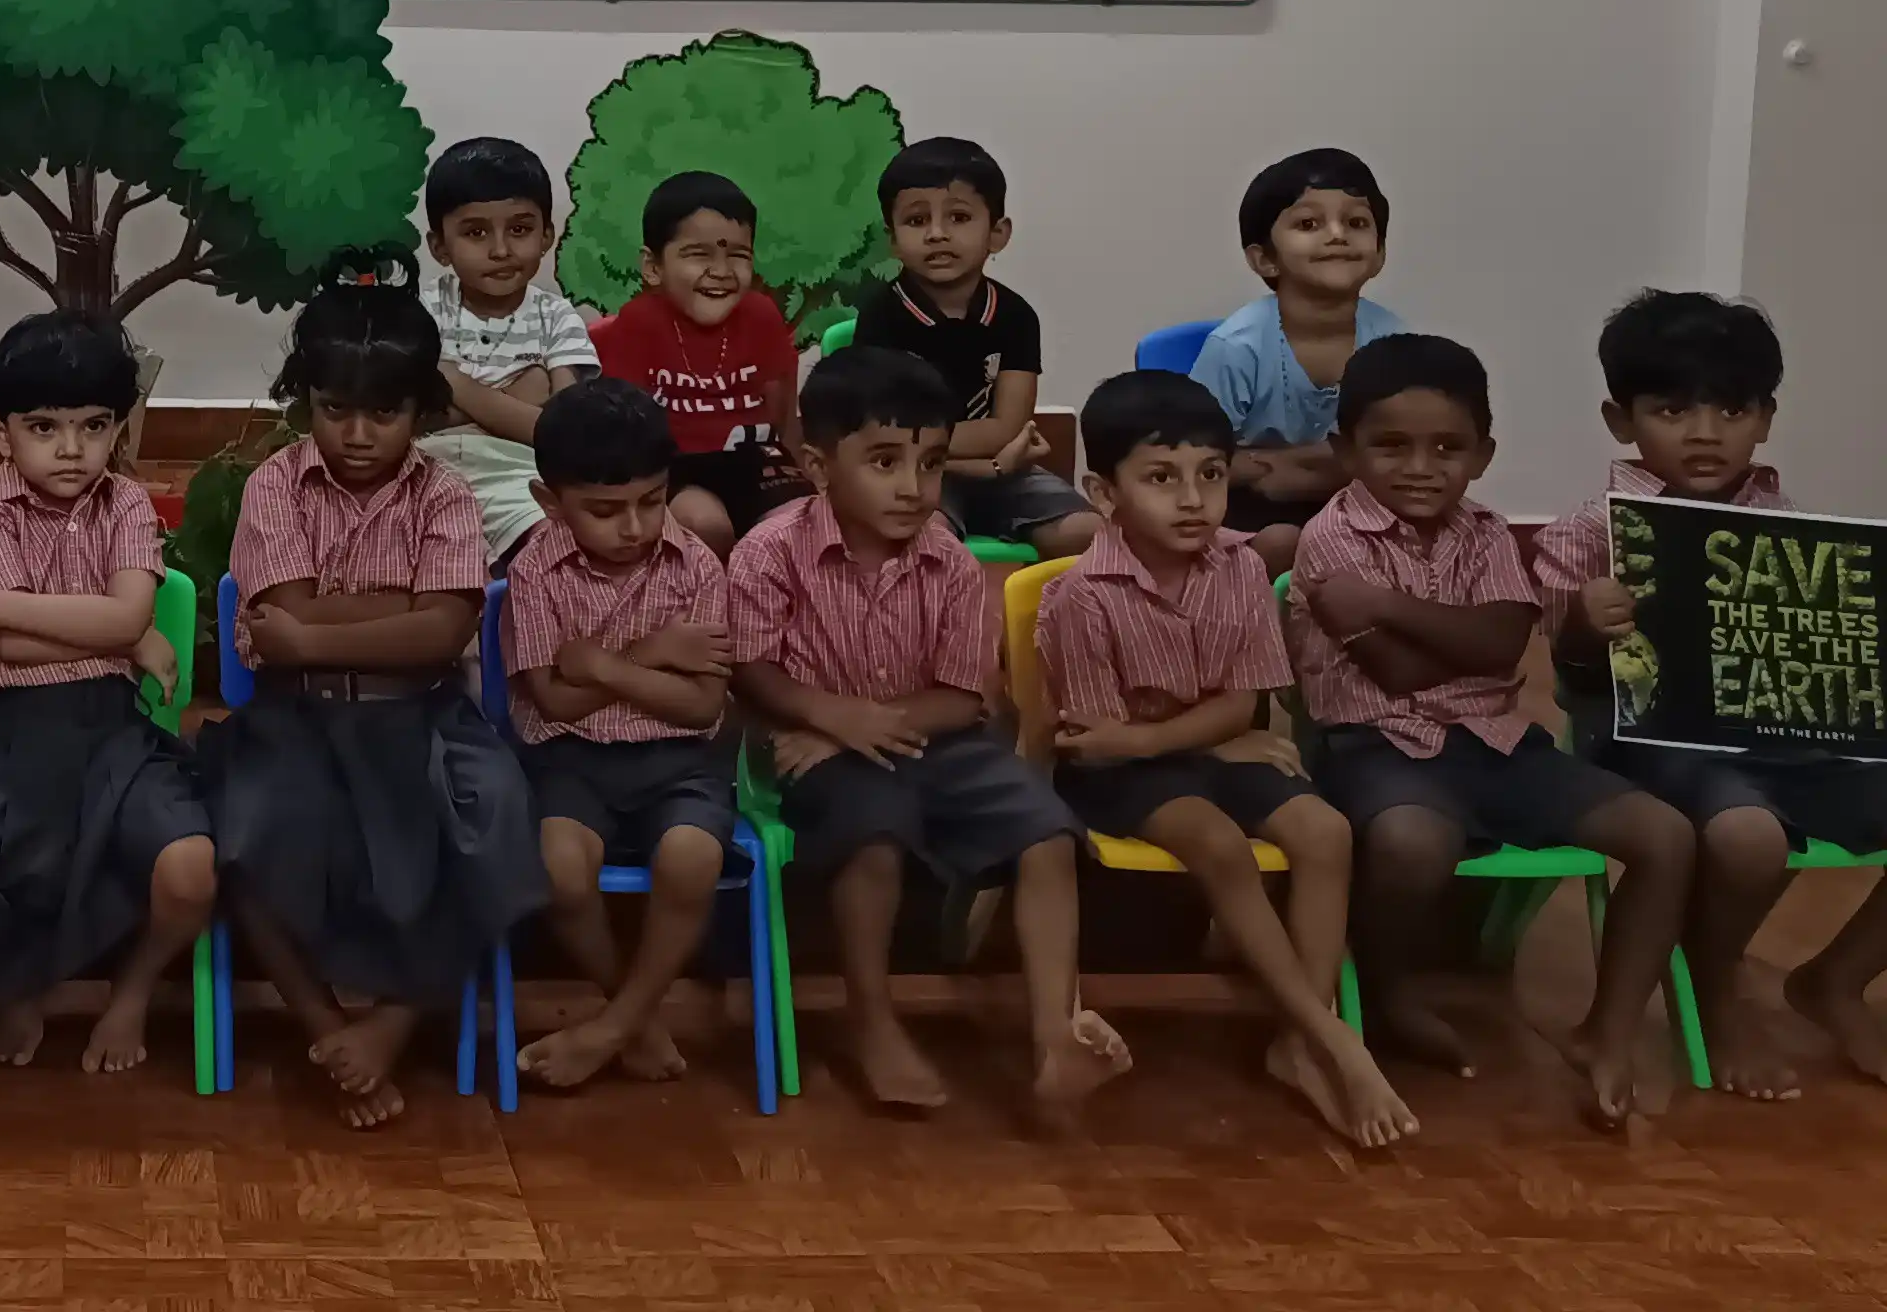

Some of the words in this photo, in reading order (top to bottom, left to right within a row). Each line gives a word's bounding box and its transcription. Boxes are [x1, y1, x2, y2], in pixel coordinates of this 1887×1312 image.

[1705, 530, 1875, 609] SAVE
[1707, 600, 1769, 628] THE
[1777, 606, 1879, 637] TREES
[1710, 627, 1791, 658] SAVE
[1711, 654, 1884, 729] EARTH
[1757, 725, 1785, 736] SAVE
[1790, 728, 1810, 738] THE
[1816, 731, 1855, 741] EARTH
